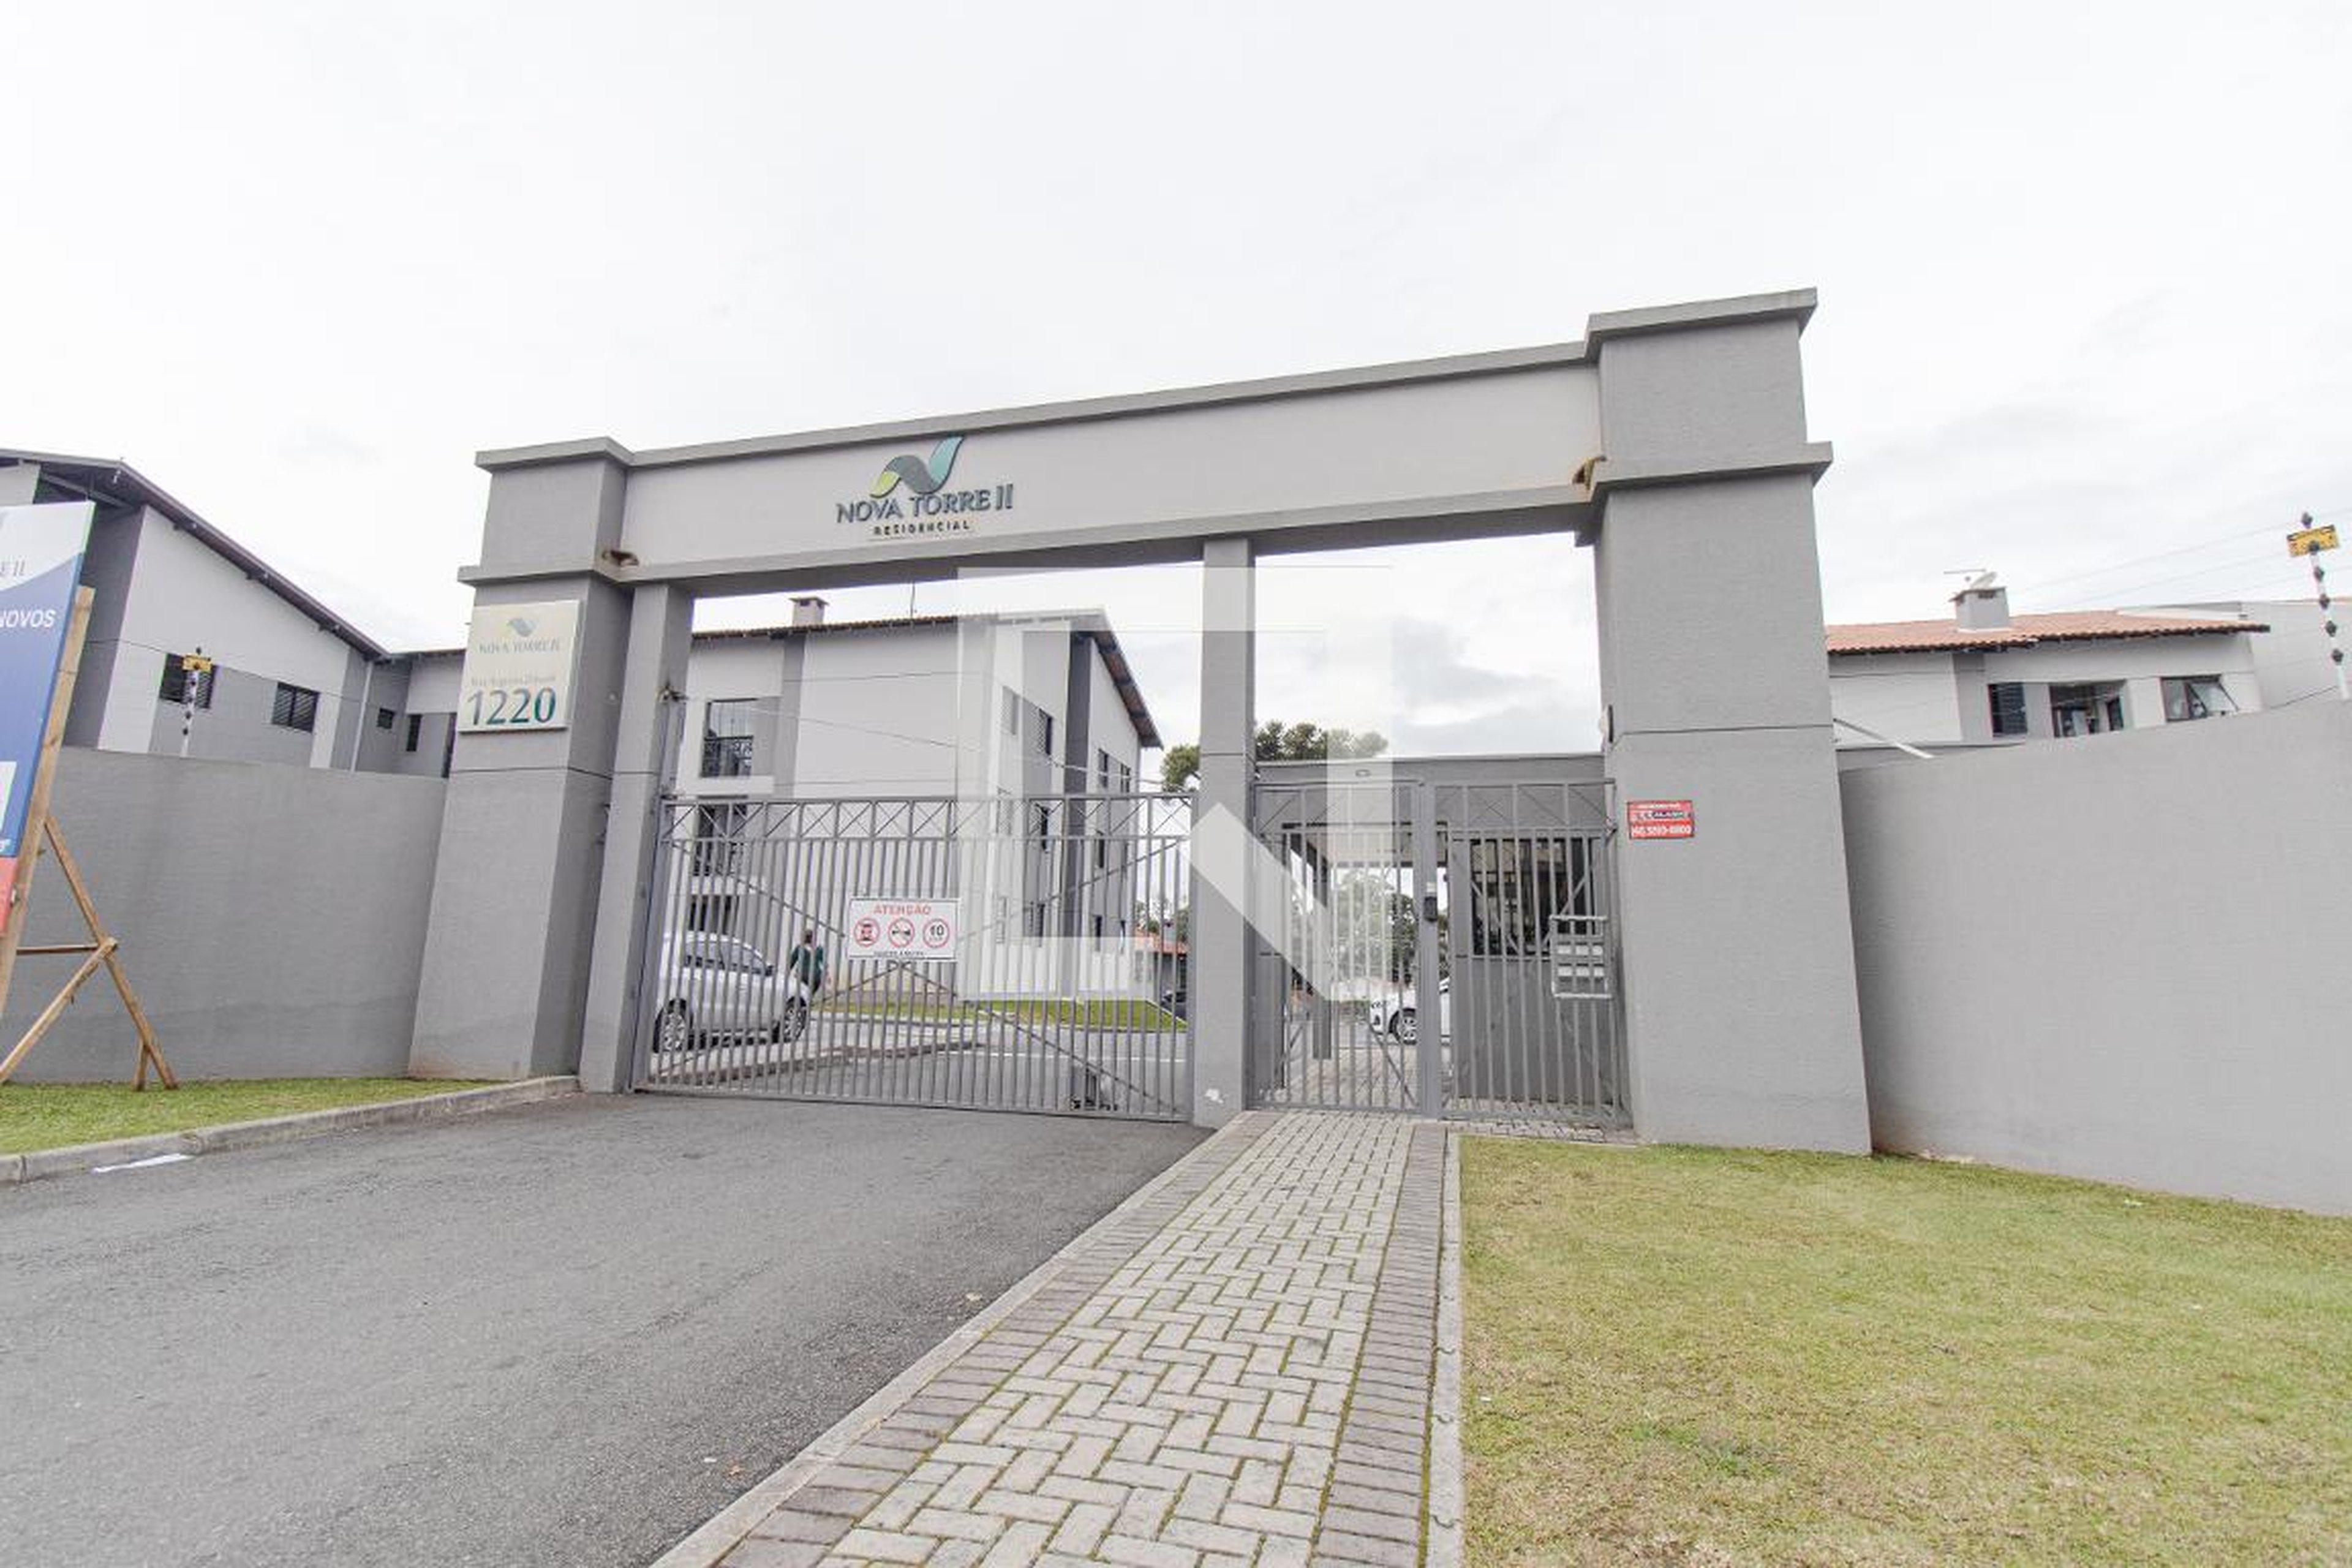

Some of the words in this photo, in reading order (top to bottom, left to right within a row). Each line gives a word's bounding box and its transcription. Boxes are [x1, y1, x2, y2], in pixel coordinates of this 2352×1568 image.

[836, 499, 903, 523] NOVA
[910, 489, 990, 517] TORRE
[874, 521, 970, 536] RESIDENCIAL
[467, 687, 556, 726] 1220
[930, 924, 944, 936] 10
